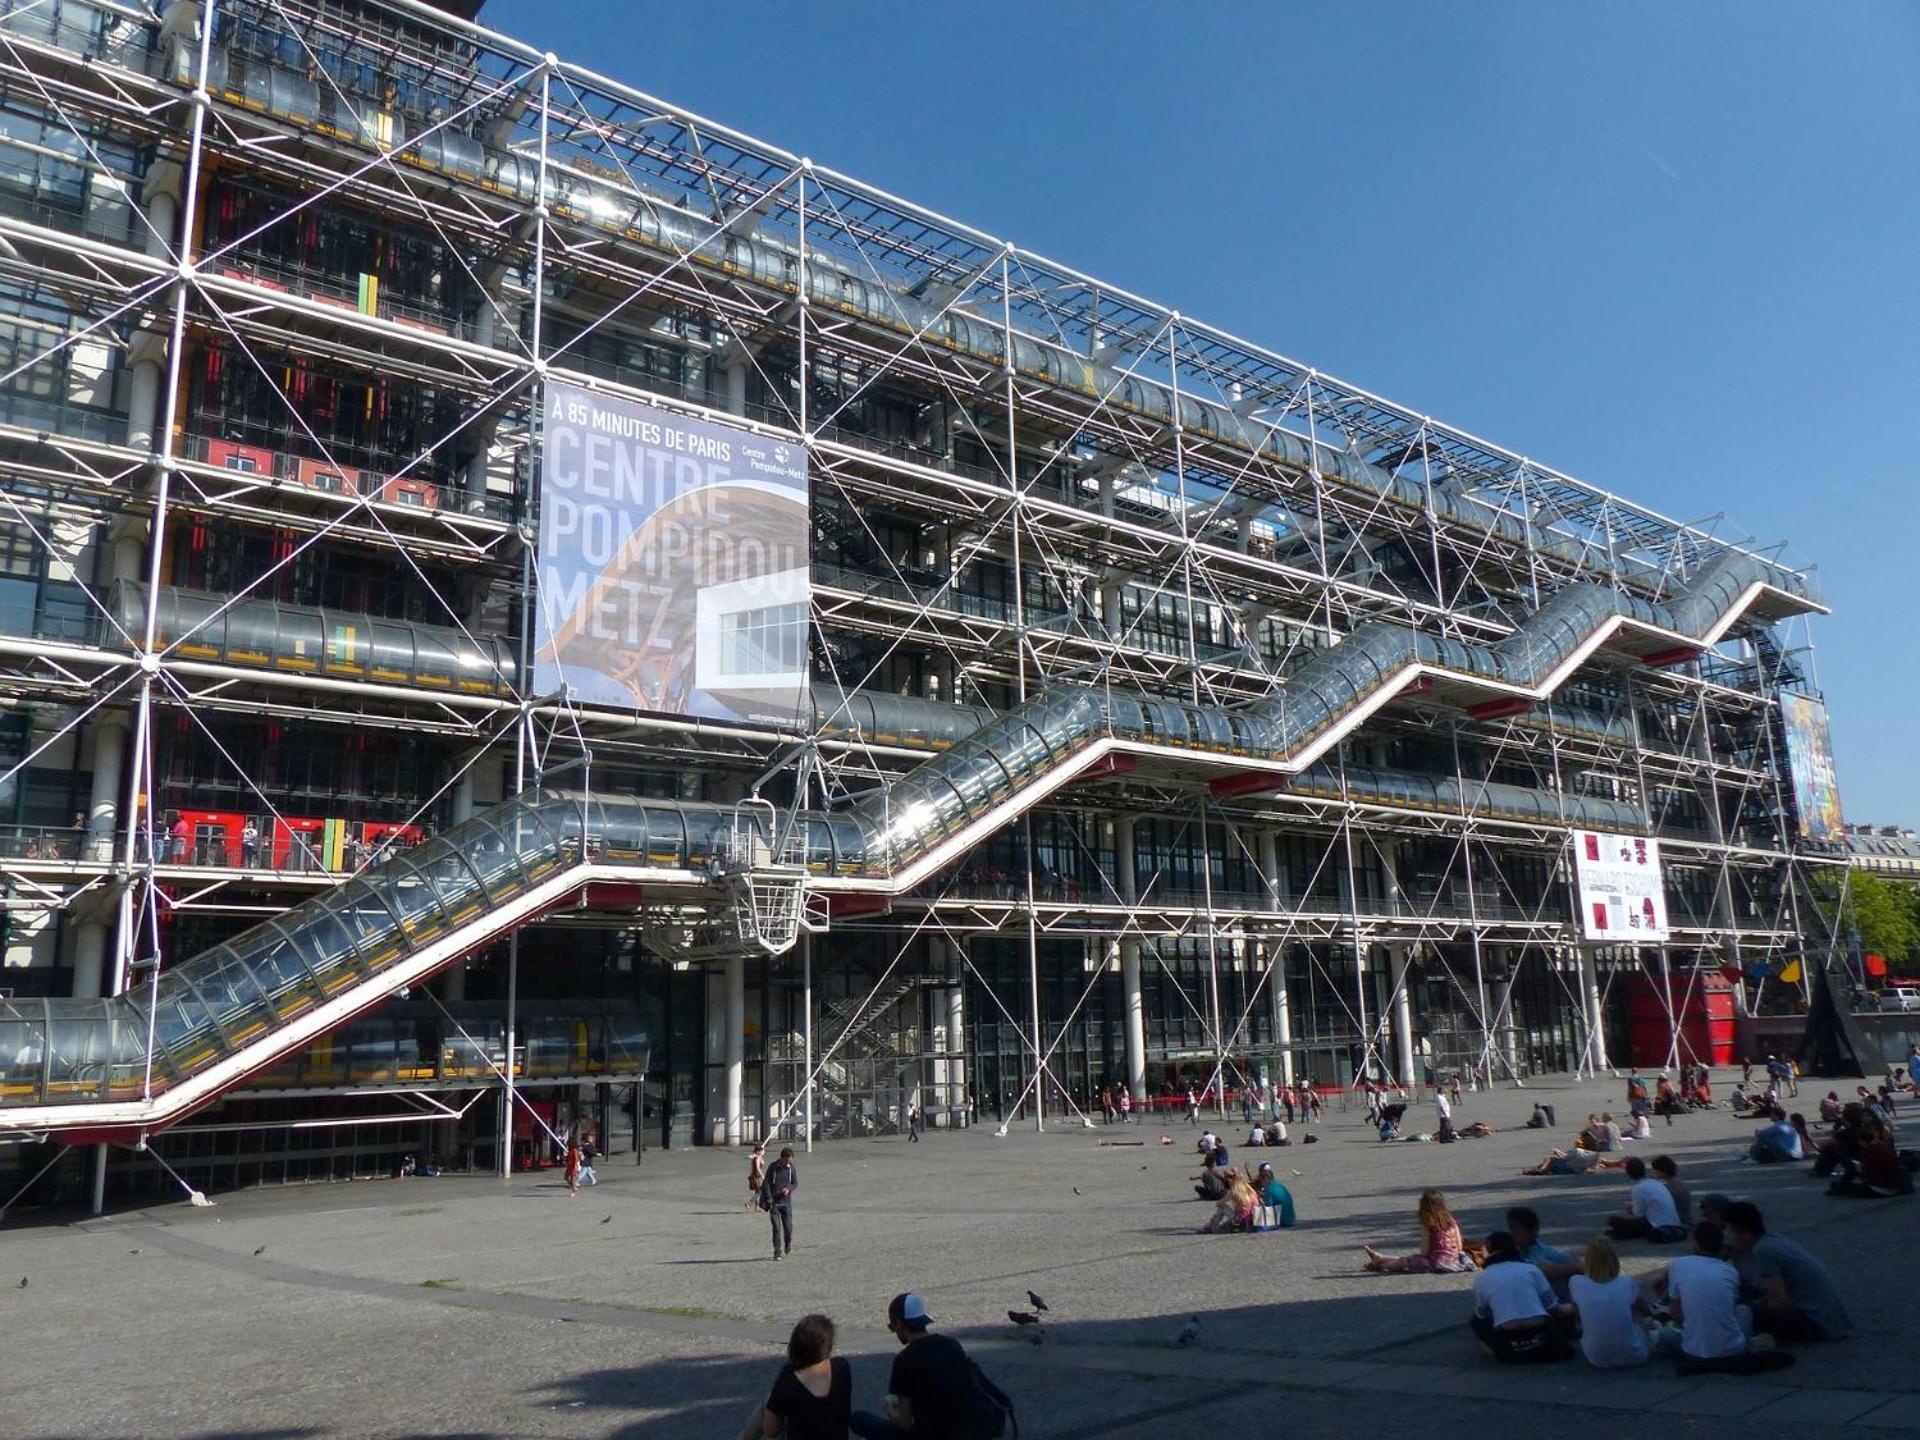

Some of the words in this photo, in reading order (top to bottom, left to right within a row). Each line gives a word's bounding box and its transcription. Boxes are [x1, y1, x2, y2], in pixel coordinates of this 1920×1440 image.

[551, 394, 563, 420] À
[568, 402, 587, 426] 85
[592, 409, 661, 445] MINUTES
[665, 427, 685, 451] DE
[688, 432, 732, 463] PARIS
[550, 427, 732, 523] CENTRE
[547, 495, 795, 598] POMPIDOU
[545, 566, 674, 648] METZ
